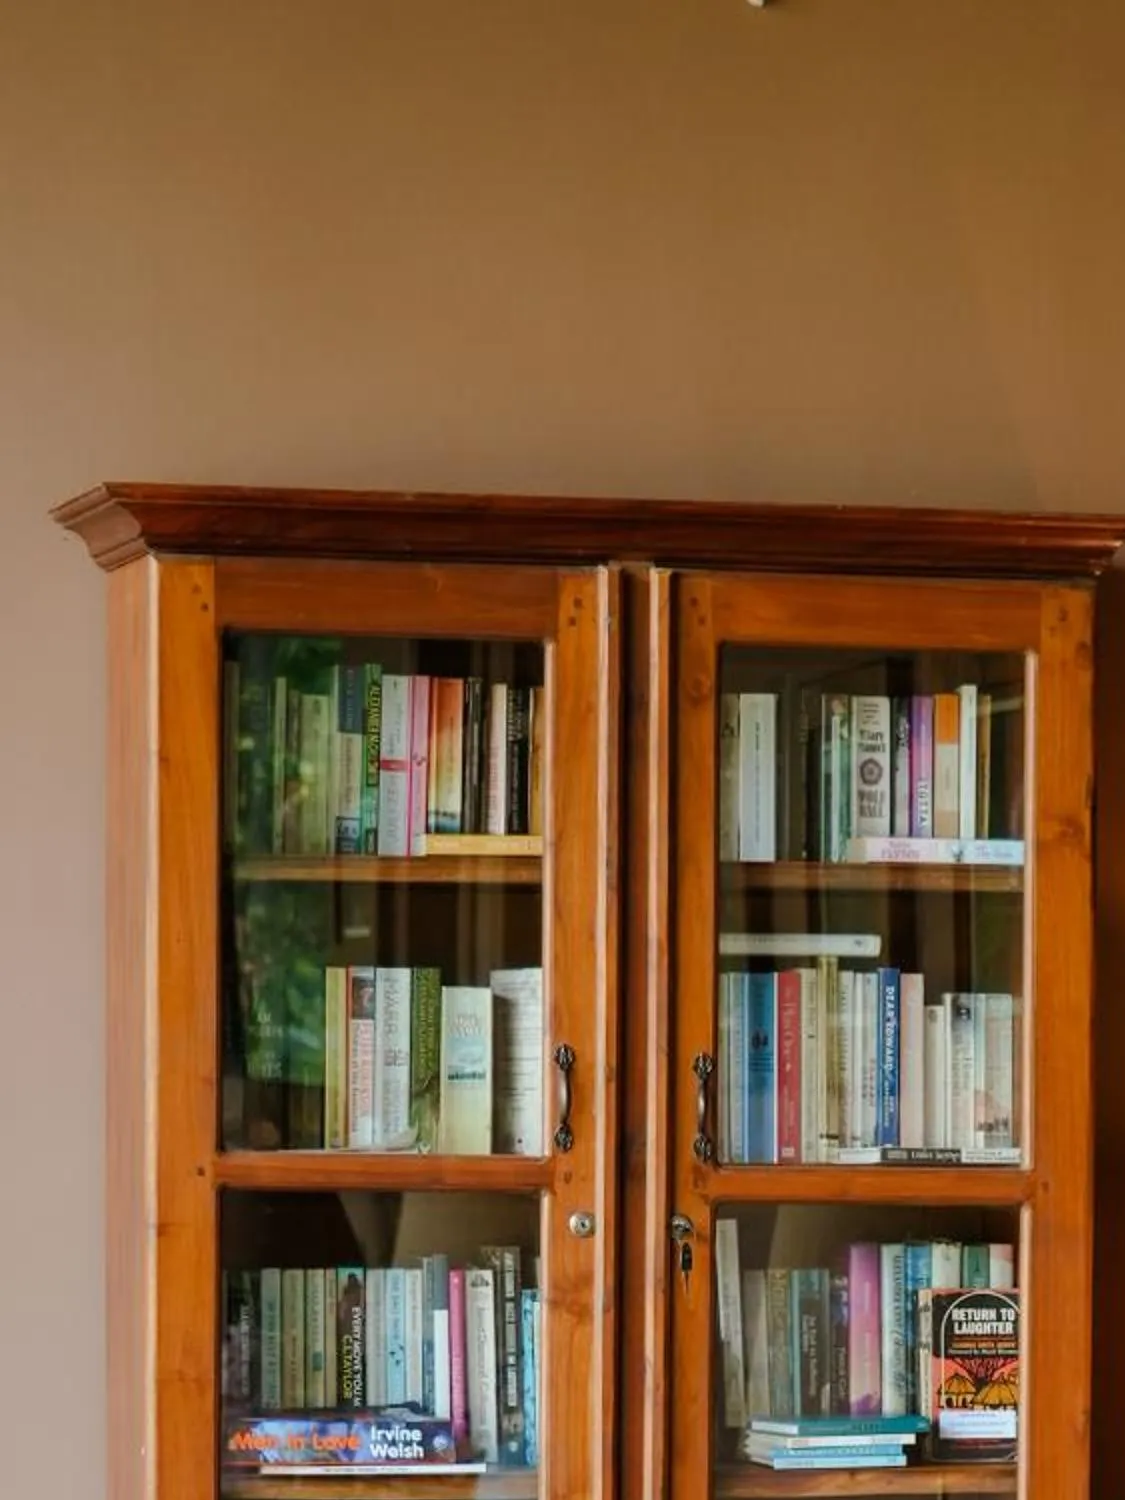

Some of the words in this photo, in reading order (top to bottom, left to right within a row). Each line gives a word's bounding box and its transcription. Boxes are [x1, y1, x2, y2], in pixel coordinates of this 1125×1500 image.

[351, 1307, 362, 1339] EVERY
[951, 1307, 997, 1321] RETURN
[1001, 1308, 1015, 1321] TO
[953, 1321, 1014, 1335] LAUGHTER
[351, 1340, 362, 1372] MOVE
[342, 1356, 353, 1399] TAYLOR
[352, 1373, 362, 1396] YOU
[287, 1433, 306, 1450] in
[312, 1430, 361, 1450] Love
[370, 1425, 423, 1443] Irvine
[369, 1442, 425, 1459] Welsh
